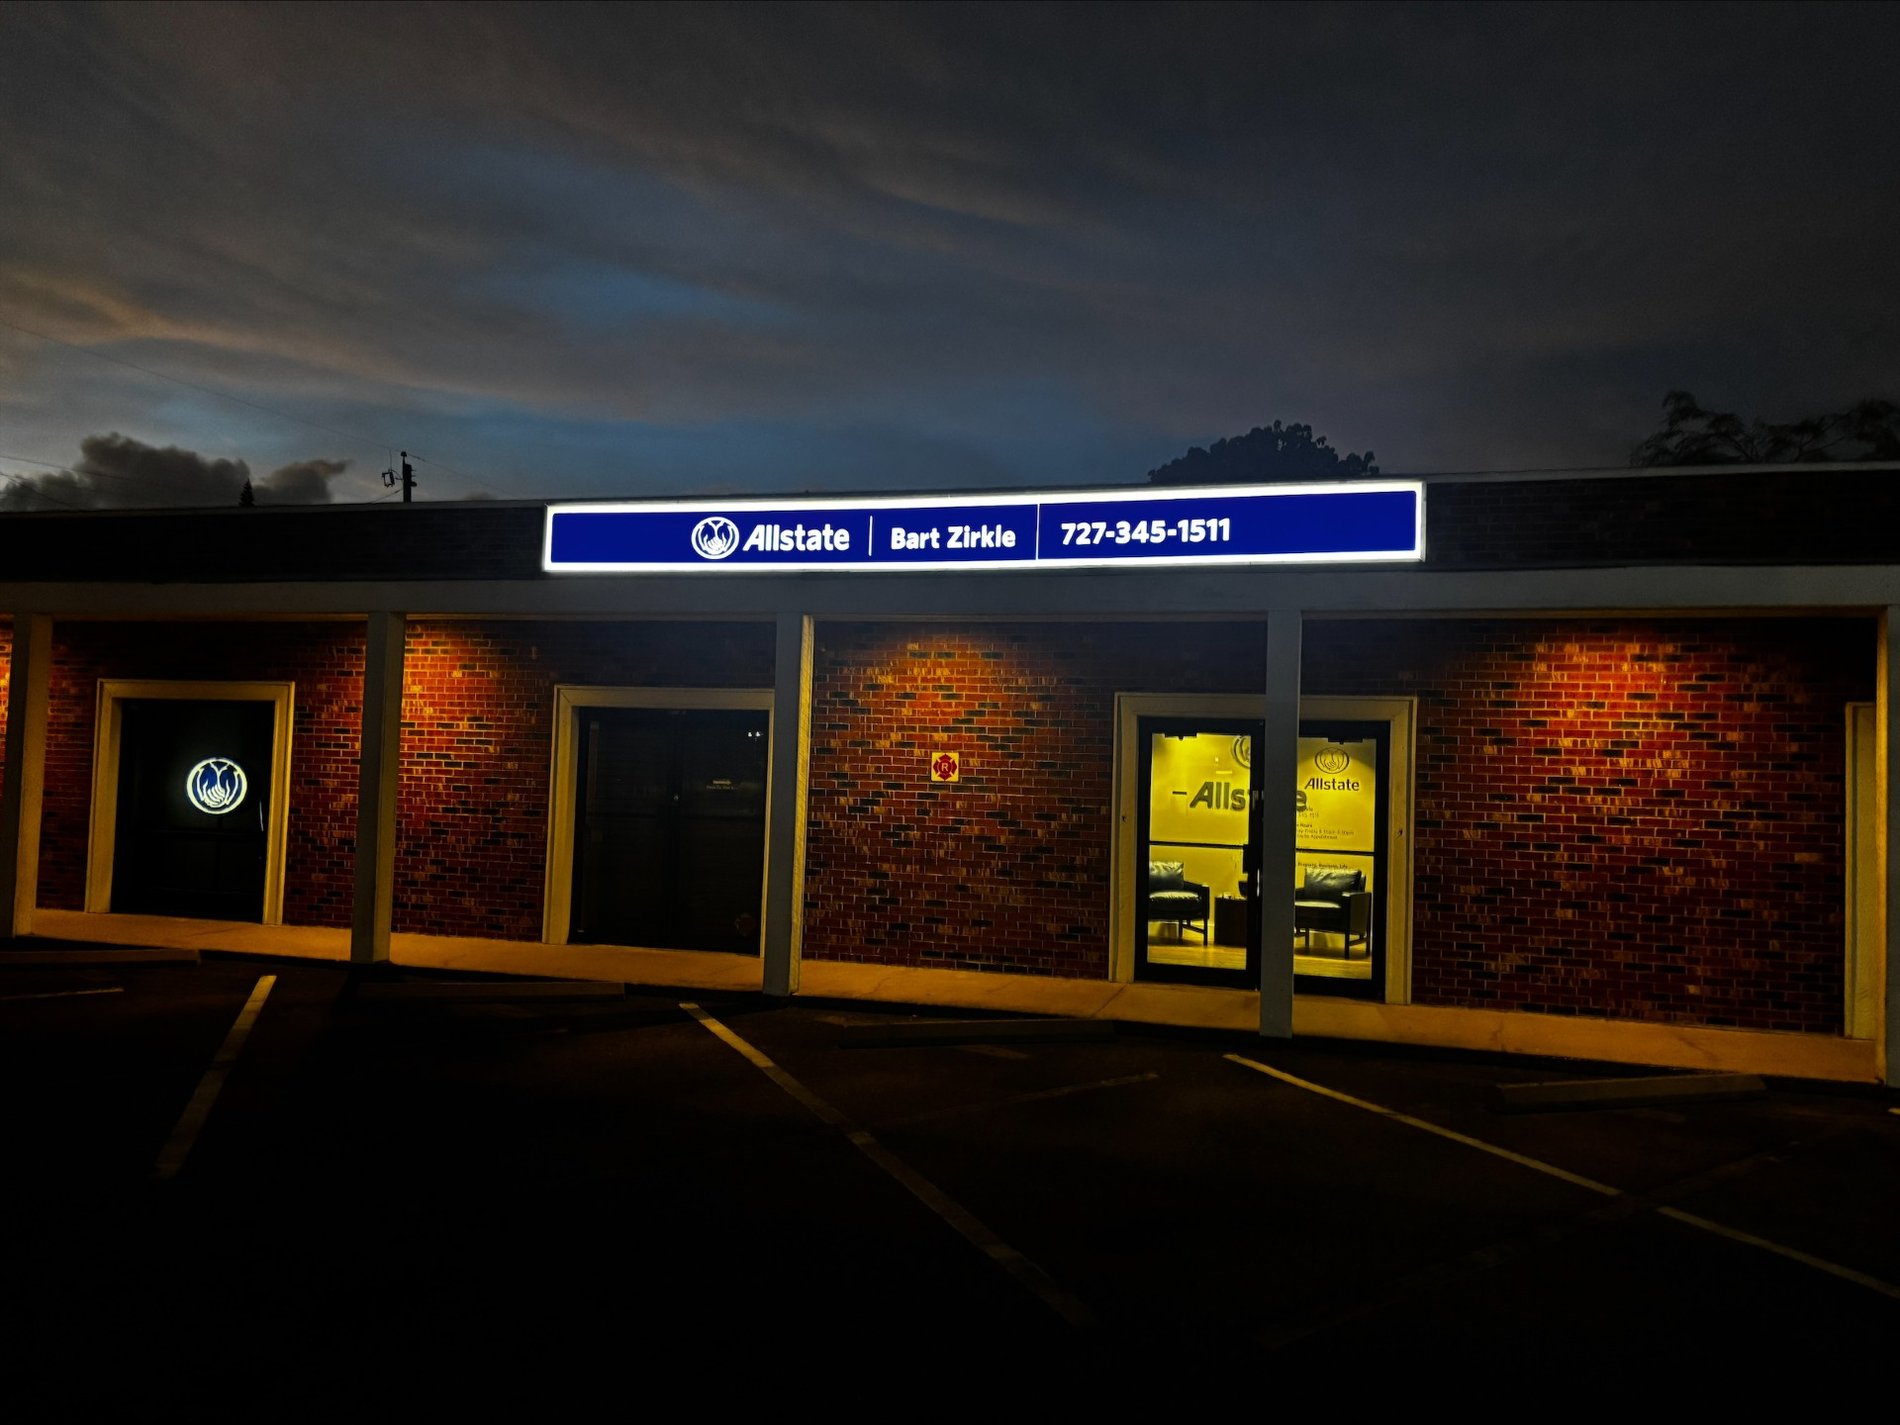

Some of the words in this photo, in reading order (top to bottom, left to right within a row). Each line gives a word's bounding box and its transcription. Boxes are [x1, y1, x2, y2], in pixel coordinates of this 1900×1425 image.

[742, 523, 850, 552] Allstate
[890, 527, 939, 550] Bart
[946, 523, 1016, 549] Zirkle
[1061, 518, 1231, 546] 727-345-1511
[941, 762, 949, 772] R
[1304, 777, 1360, 791] Allstate
